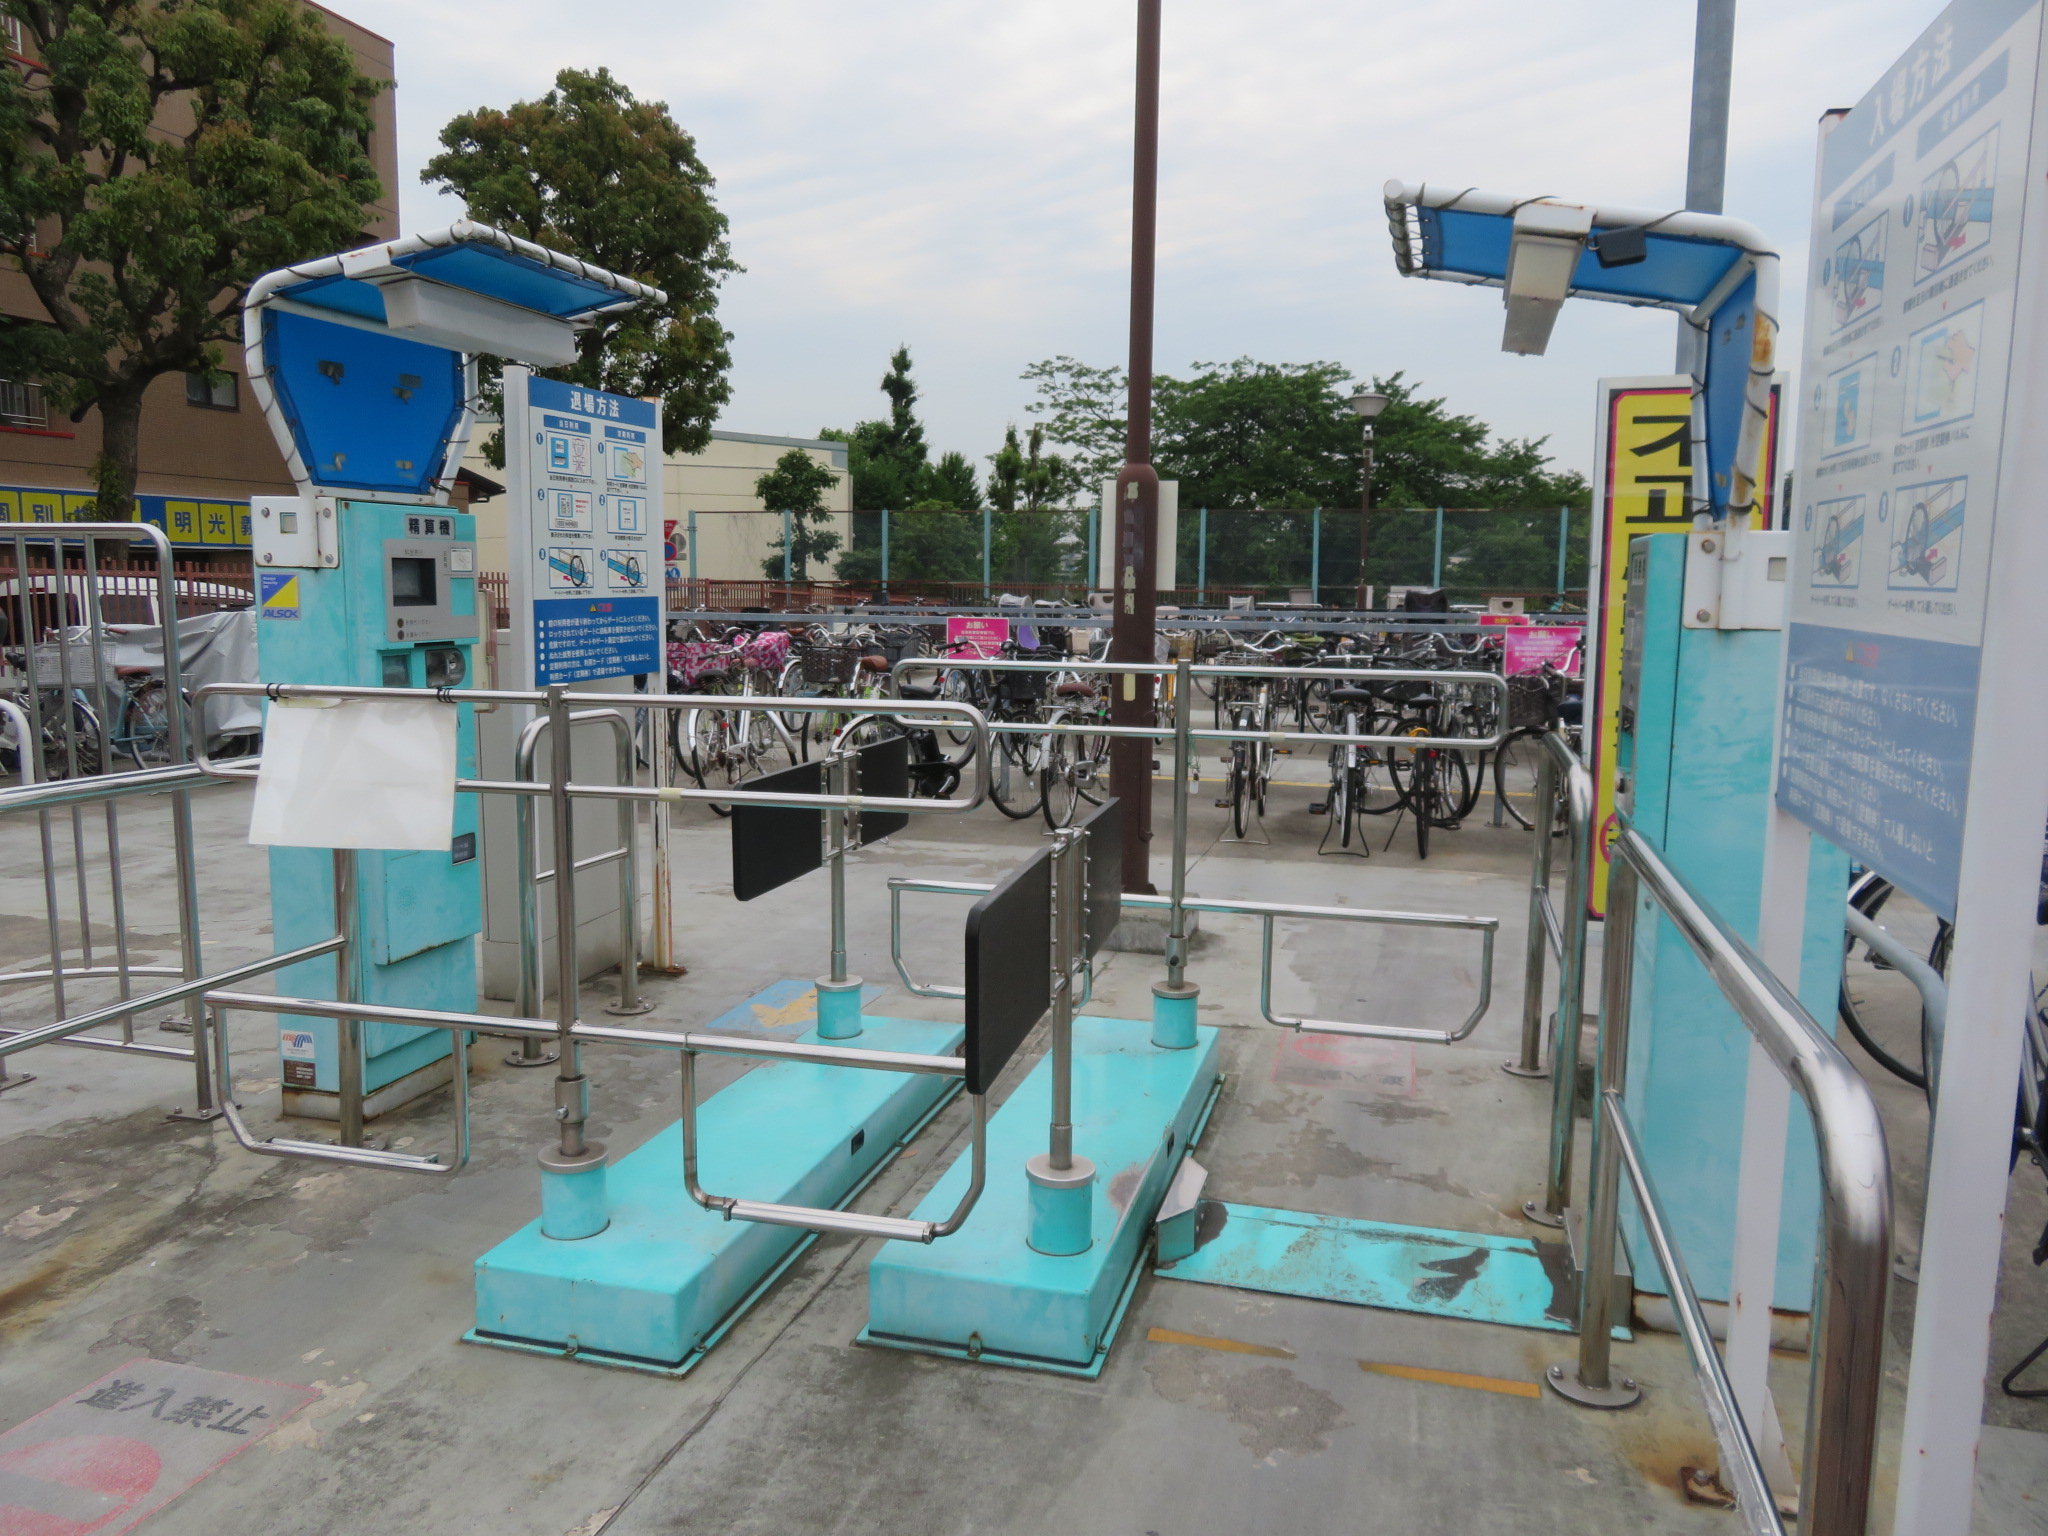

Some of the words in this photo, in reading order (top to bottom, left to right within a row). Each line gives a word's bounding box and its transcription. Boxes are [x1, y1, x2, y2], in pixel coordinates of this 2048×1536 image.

[570, 390, 620, 418] 退場方法
[408, 518, 450, 536] 精算機
[263, 609, 299, 618] ALSOK
[965, 621, 988, 630] お願い
